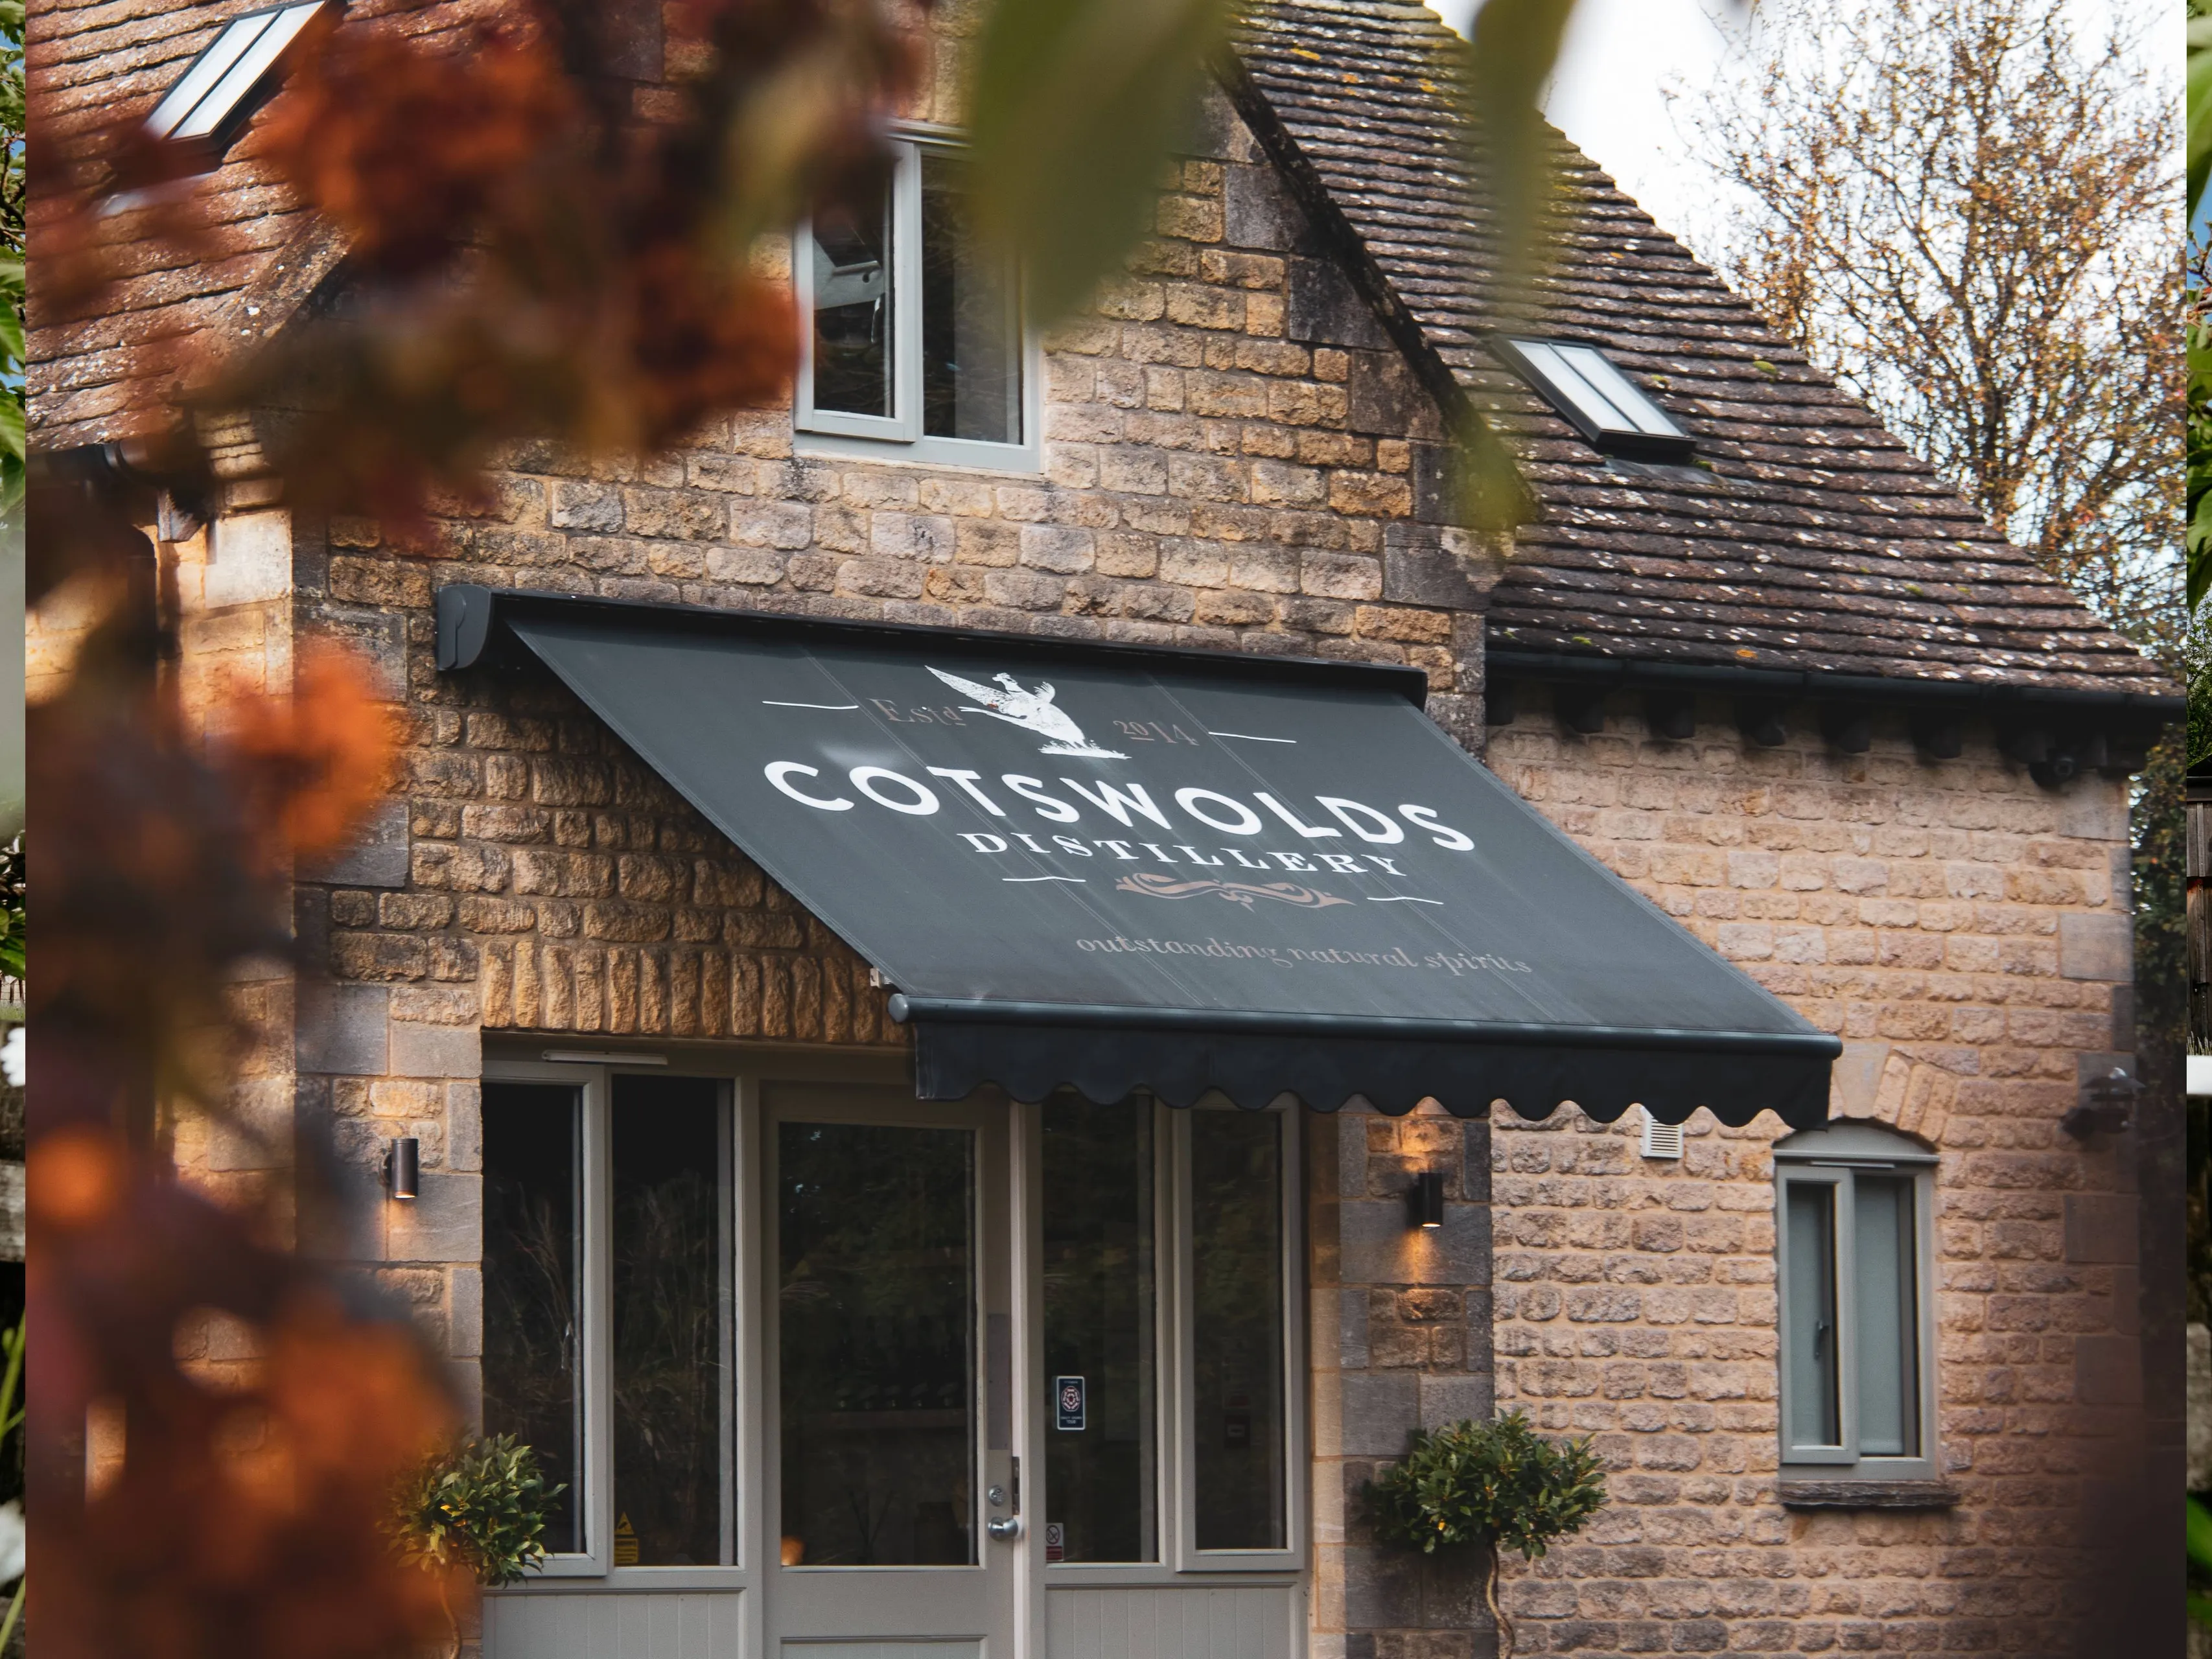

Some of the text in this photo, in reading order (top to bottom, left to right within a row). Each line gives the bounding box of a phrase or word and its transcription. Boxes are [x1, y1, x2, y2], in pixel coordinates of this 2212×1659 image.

[1113, 721, 1199, 746] 2014
[763, 761, 1475, 852] COTSWOLDS
[956, 832, 1407, 877] DISTILLERY
[1076, 937, 1533, 976] outstanding natural spirits
